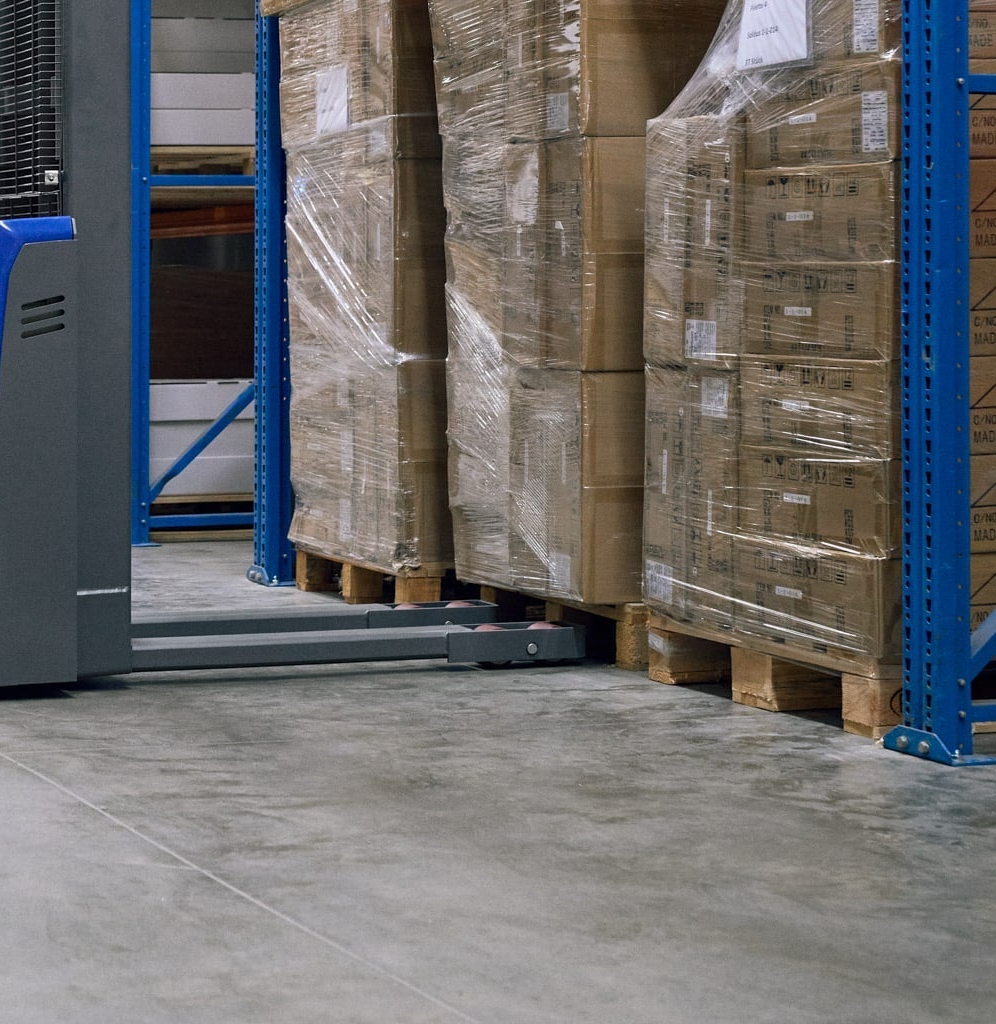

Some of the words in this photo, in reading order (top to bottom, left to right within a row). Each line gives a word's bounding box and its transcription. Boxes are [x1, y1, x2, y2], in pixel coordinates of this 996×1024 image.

[974, 333, 996, 345] MAD
[973, 431, 996, 444] MAD
[973, 529, 996, 542] MAD
